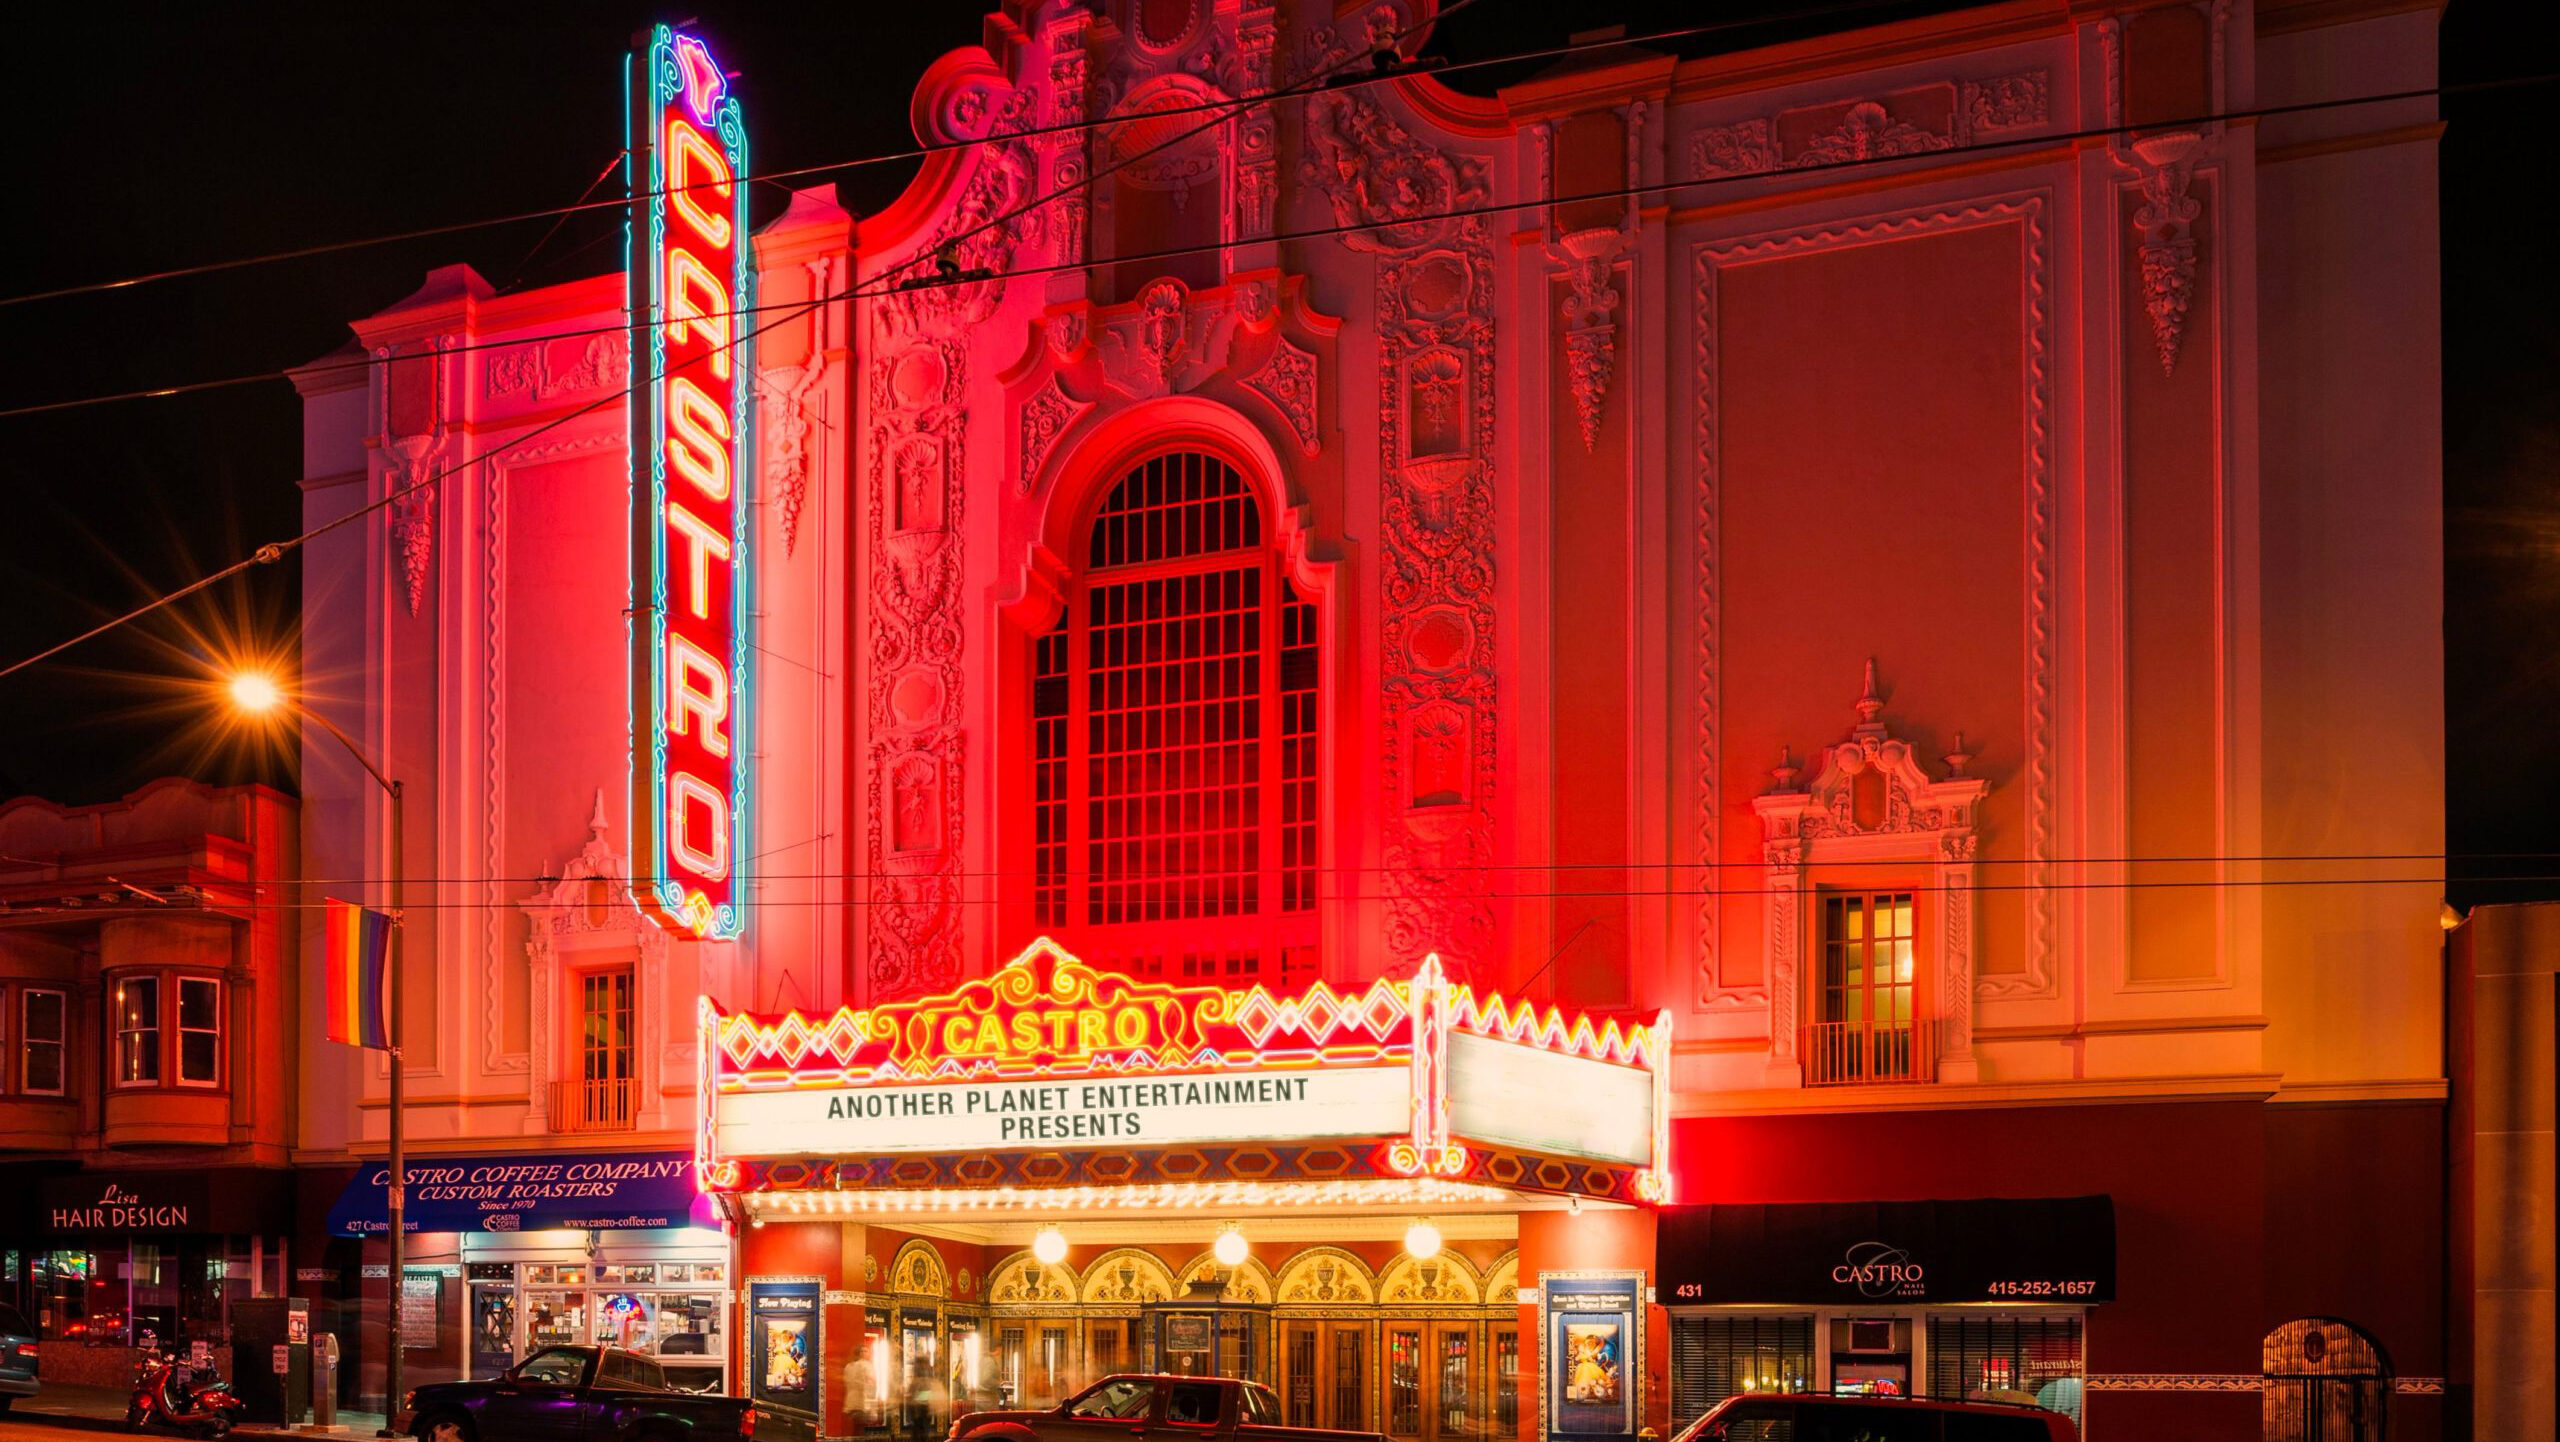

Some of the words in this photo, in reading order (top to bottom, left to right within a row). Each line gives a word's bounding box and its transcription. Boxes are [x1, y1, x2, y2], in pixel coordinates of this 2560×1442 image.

[667, 118, 731, 884] CASTRO
[943, 1006, 1148, 1053] CASTRO
[827, 1092, 954, 1119] ANOTHER
[966, 1087, 1070, 1114] PLANET
[1082, 1077, 1309, 1109] ENTERTAINMENT
[1001, 1112, 1141, 1140] PRESENTS
[470, 1165, 562, 1183] COFFEE
[566, 1160, 692, 1180] COMPANY
[98, 1184, 138, 1205] Lisa
[418, 1185, 503, 1200] CUSTOM
[507, 1182, 617, 1198] ROASTERS
[477, 1201, 509, 1210] Since
[511, 1200, 536, 1209] 1970
[53, 1208, 105, 1228] HAIR
[112, 1206, 187, 1227] DESIGN
[346, 1221, 362, 1231] 427
[402, 1221, 418, 1231] reet
[563, 1216, 668, 1228] www.castro-coffee.com
[1832, 1264, 1923, 1283] CASTRO
[1676, 1284, 1702, 1297] 431
[1988, 1281, 2096, 1295] 415-252-1657
[759, 1297, 778, 1308] Now
[780, 1297, 812, 1309] Playing
